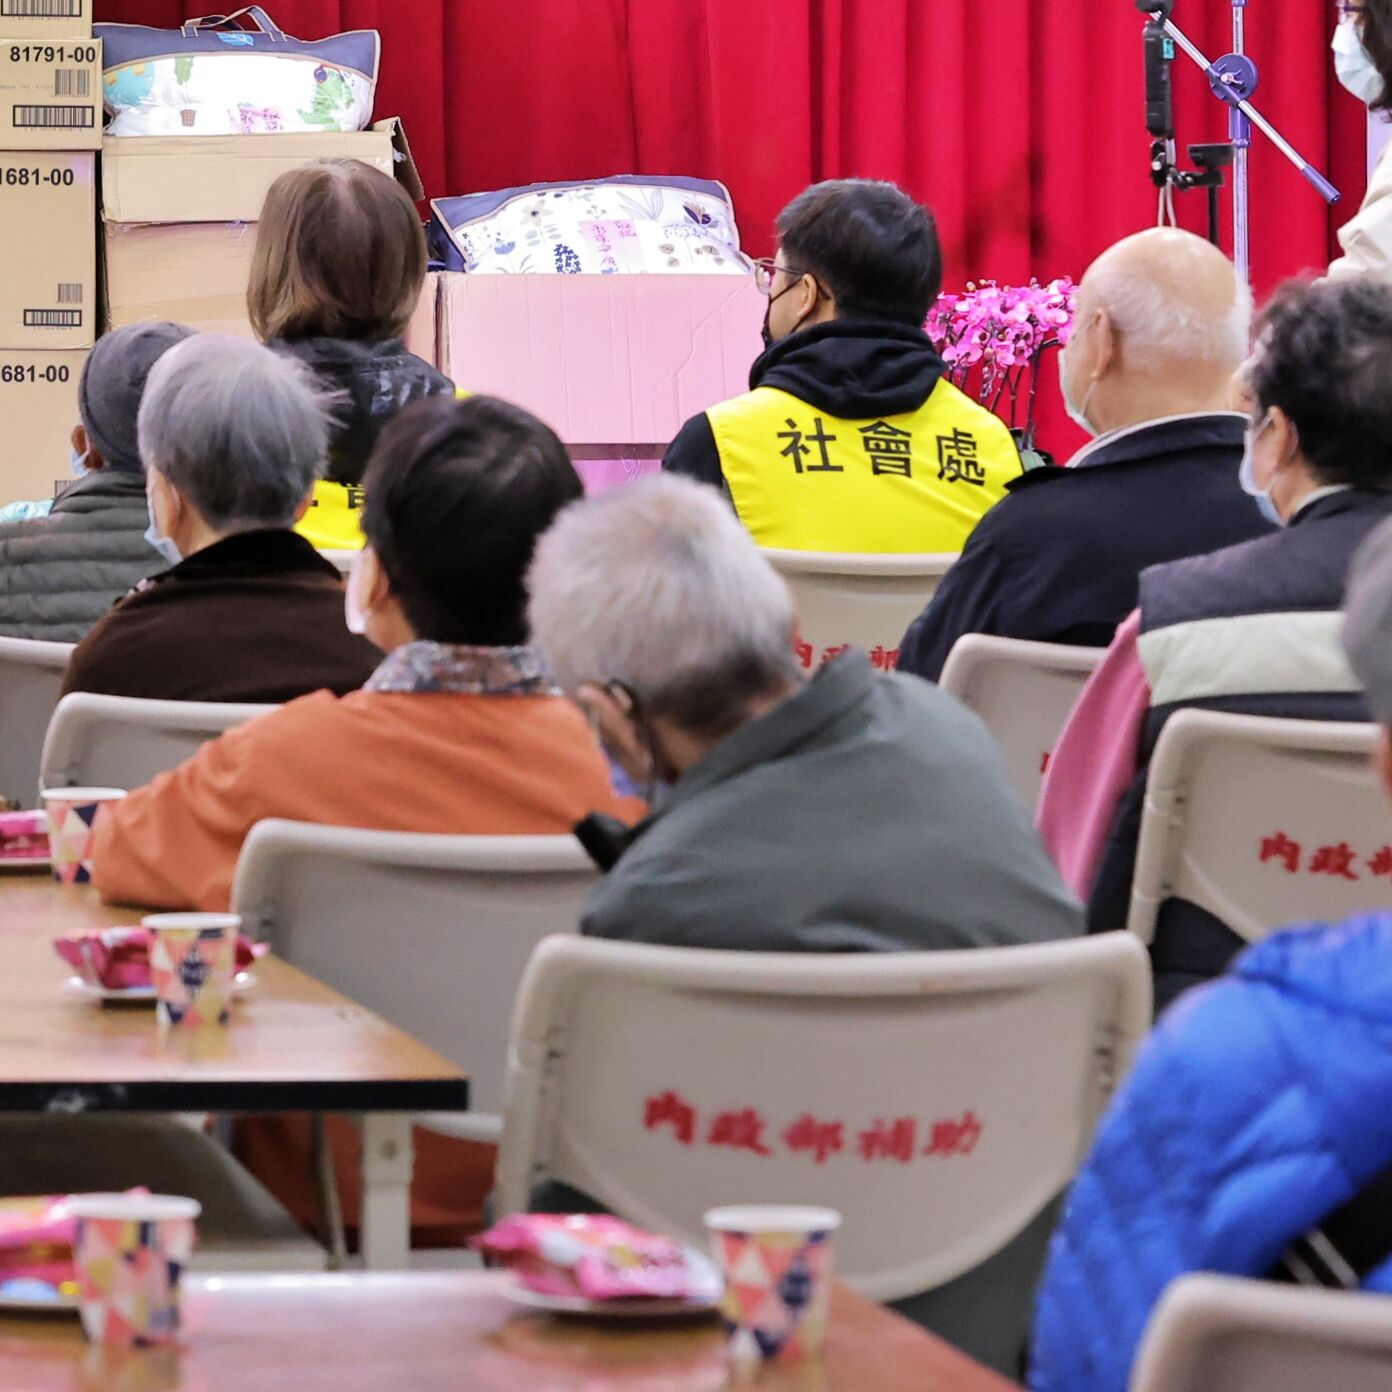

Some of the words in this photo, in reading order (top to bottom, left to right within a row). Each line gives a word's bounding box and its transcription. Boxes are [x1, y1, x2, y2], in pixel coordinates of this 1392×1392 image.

[10, 47, 96, 63] 81791-00
[777, 417, 985, 486] 社會處
